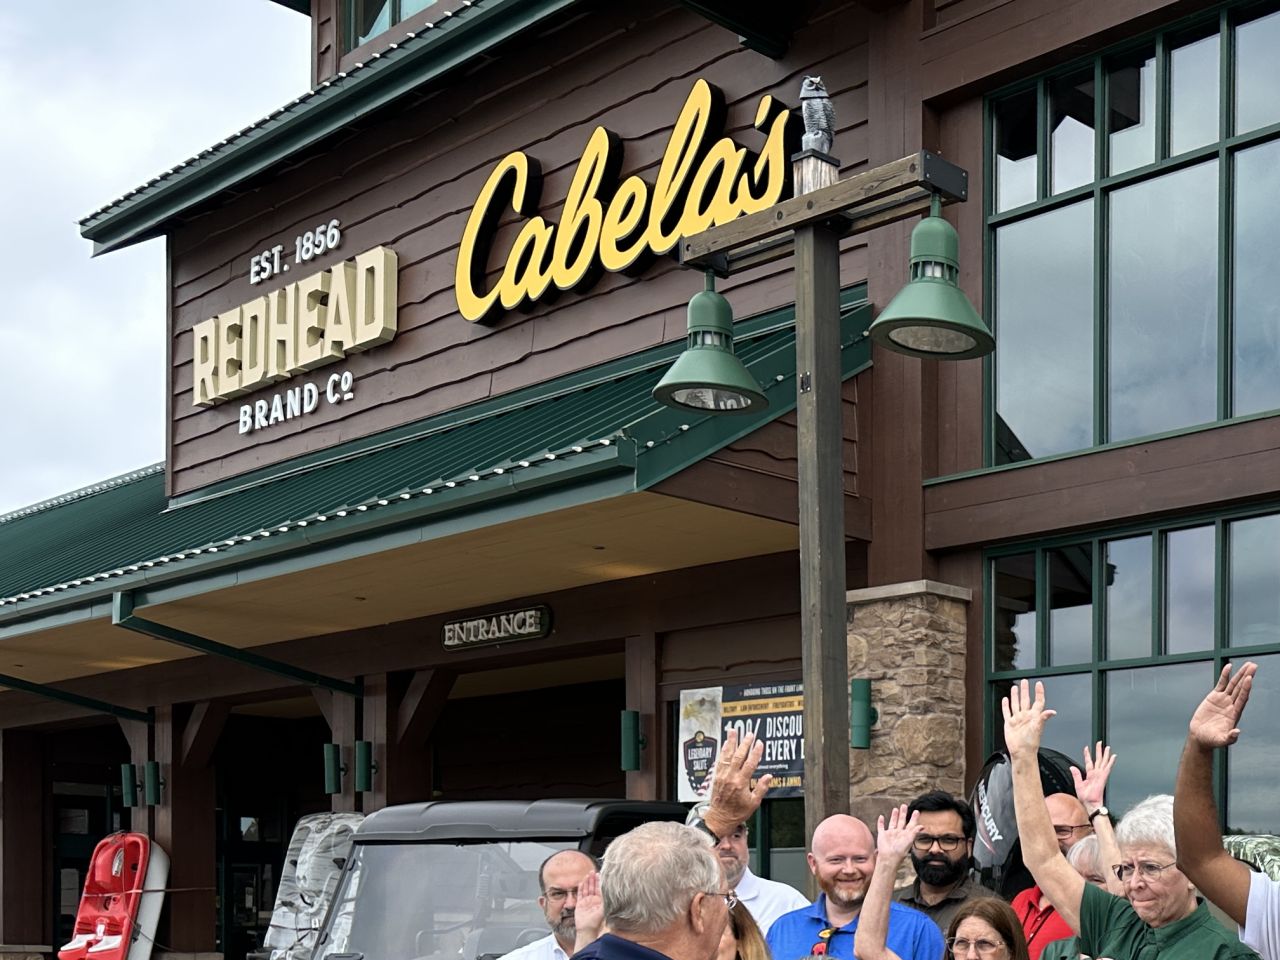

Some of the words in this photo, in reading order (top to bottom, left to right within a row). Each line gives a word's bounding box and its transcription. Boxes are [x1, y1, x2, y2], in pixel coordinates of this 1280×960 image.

[455, 78, 791, 323] Cabela's
[250, 245, 290, 285] EST.
[295, 219, 341, 264] 1856
[193, 246, 398, 408] REDHEAD
[239, 382, 319, 434] BRAND
[444, 610, 540, 646] ENTRANCE
[765, 739, 797, 761] EVERY
[978, 778, 1003, 842] MERCURY
